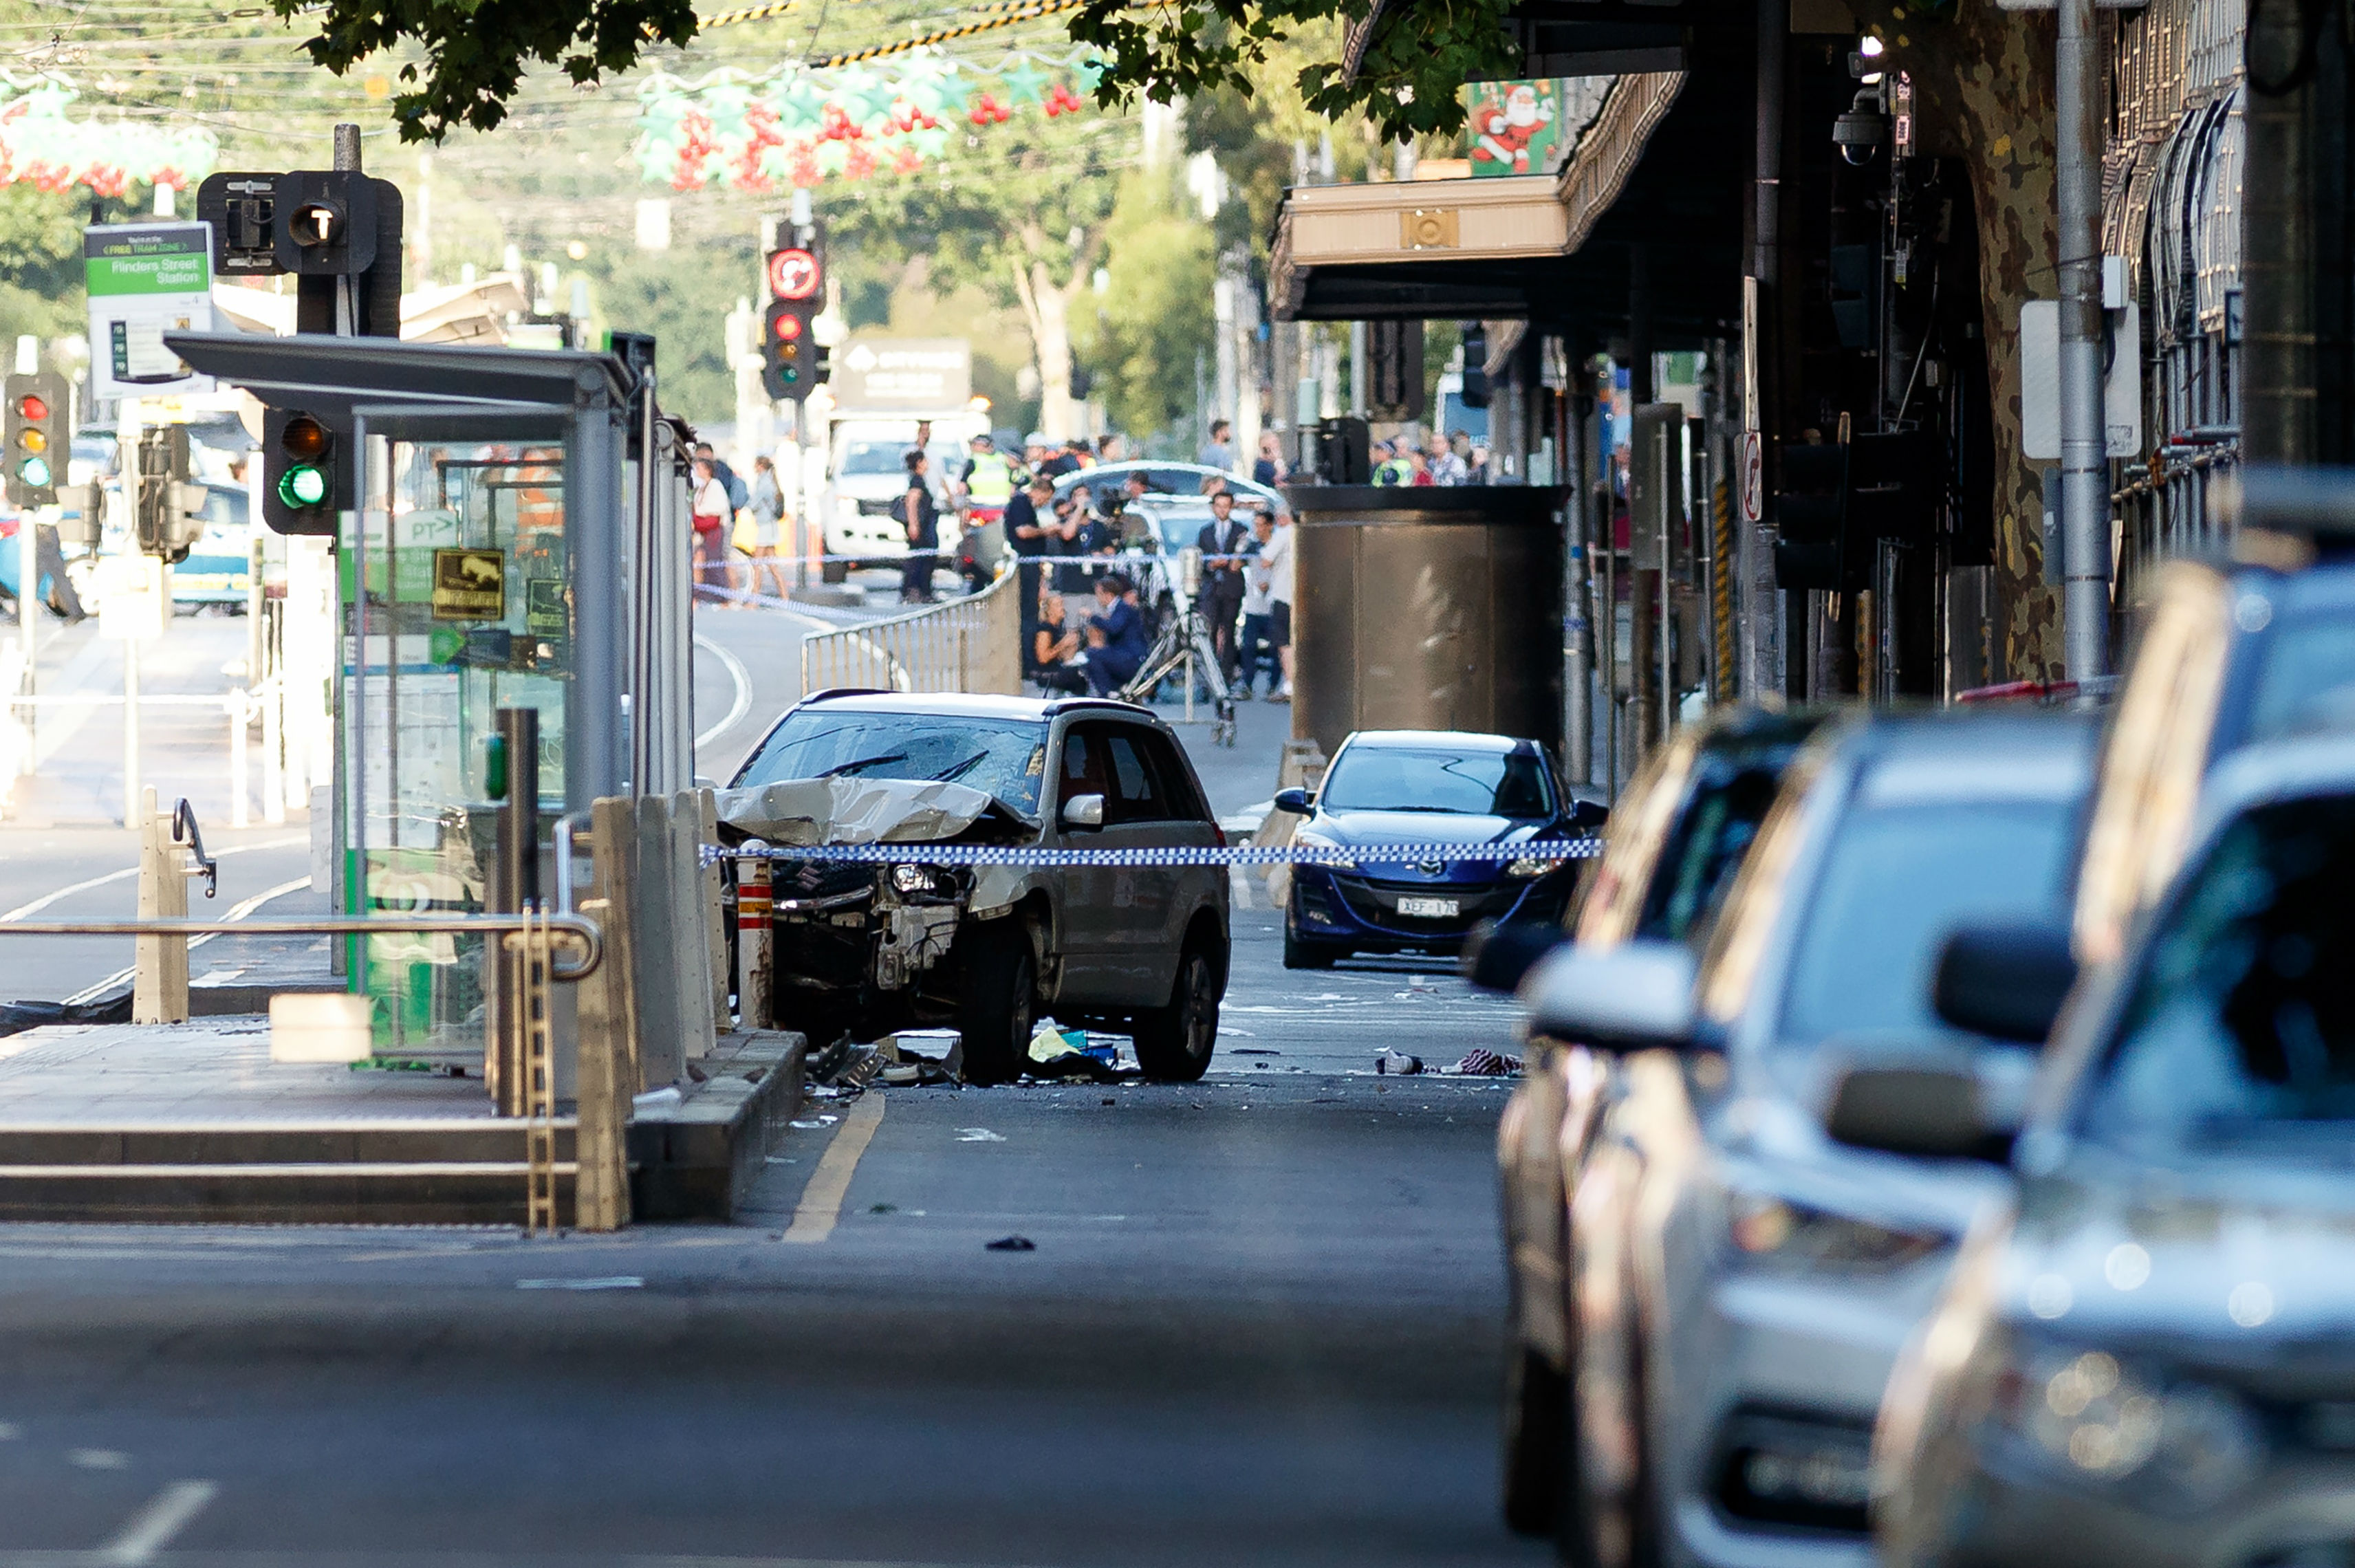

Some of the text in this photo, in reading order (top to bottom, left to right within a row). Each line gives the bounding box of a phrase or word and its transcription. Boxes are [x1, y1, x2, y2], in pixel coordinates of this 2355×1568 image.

[111, 258, 199, 274] Flinders Street
[156, 272, 199, 285] Station
